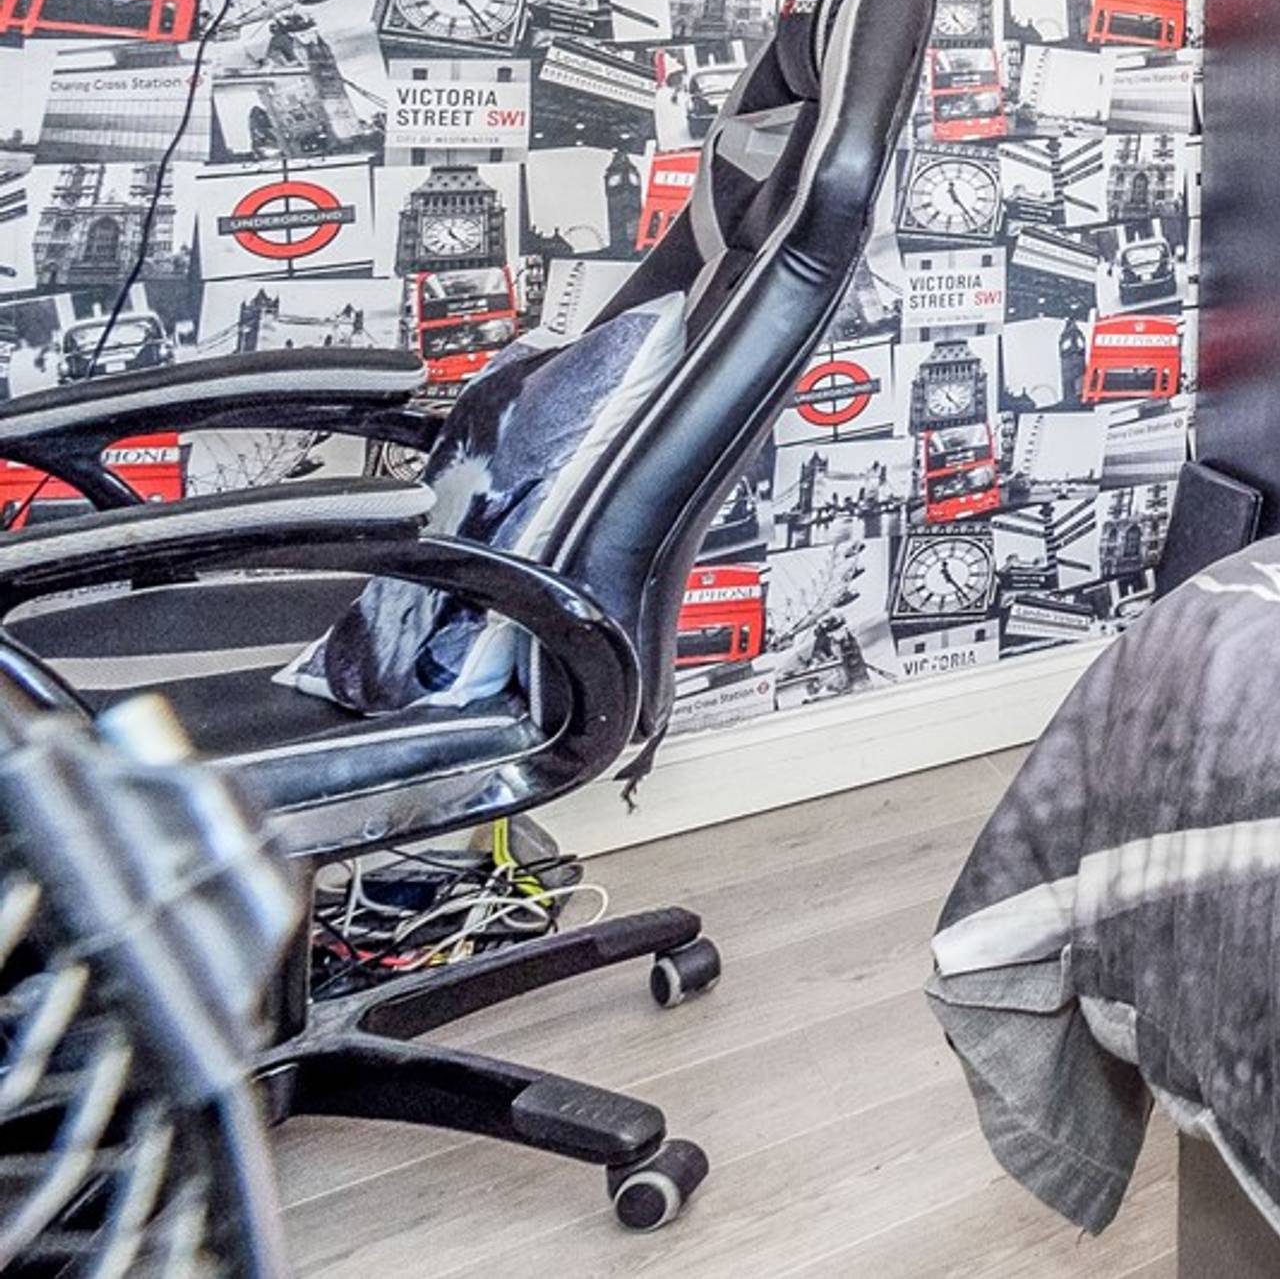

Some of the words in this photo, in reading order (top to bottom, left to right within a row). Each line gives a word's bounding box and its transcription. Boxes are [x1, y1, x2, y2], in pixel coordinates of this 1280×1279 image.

[51, 81, 90, 92] Charing
[93, 78, 128, 90] Cross
[132, 77, 181, 89] Station
[396, 88, 498, 107] VICTORIA
[396, 109, 473, 126] STREET
[487, 111, 525, 127] SW1
[230, 209, 344, 228] UNDERGROUND
[910, 275, 983, 292] VICTORIA
[910, 294, 965, 309] STREET
[974, 291, 1002, 306] SW1
[103, 448, 168, 463] HONE
[687, 587, 754, 602] EPHONE
